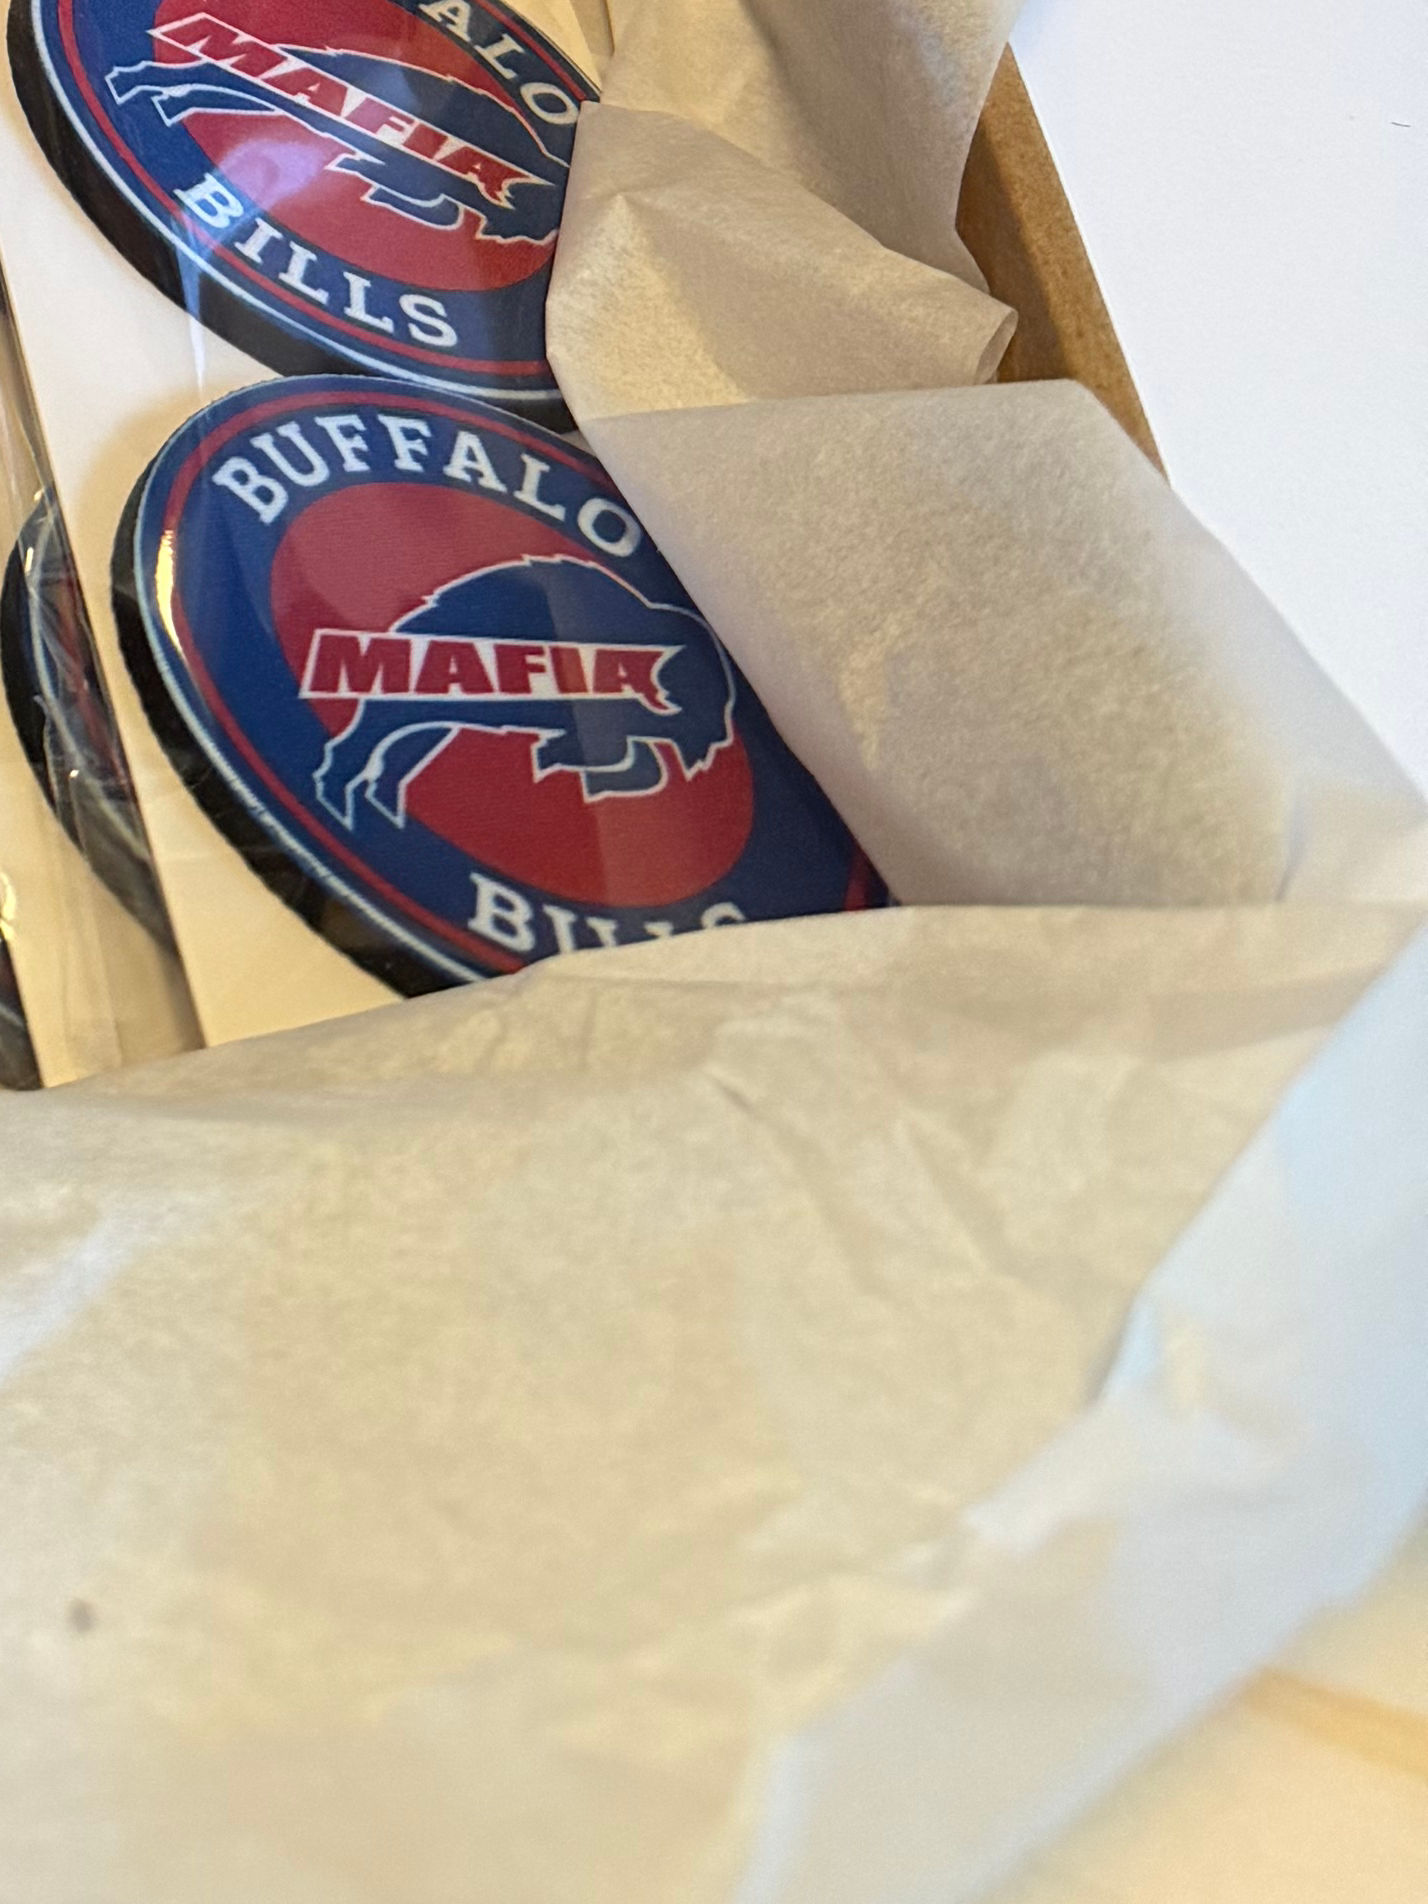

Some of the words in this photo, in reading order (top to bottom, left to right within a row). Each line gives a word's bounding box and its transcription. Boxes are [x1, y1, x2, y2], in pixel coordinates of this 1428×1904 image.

[154, 16, 539, 207] MAFIA
[172, 171, 459, 349] BILLS
[211, 412, 644, 559] BUFFALO
[306, 633, 674, 712] MAFIA
